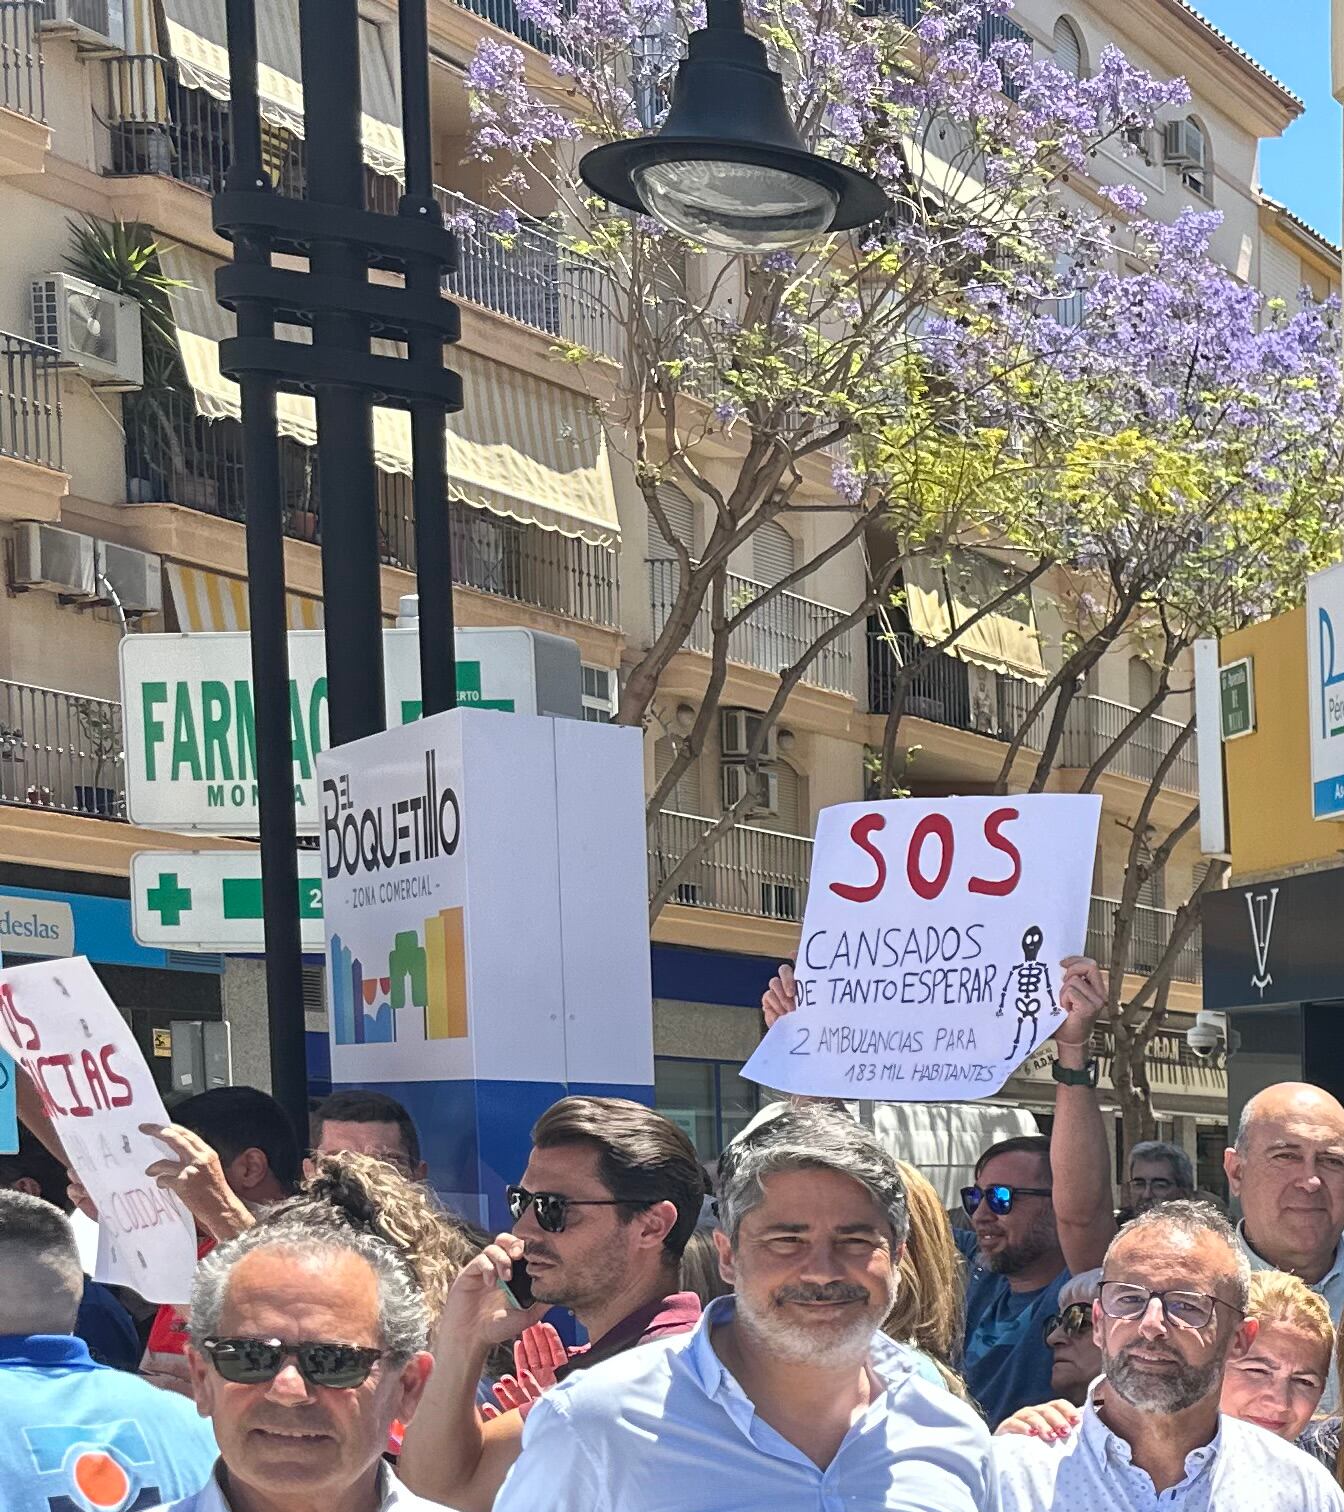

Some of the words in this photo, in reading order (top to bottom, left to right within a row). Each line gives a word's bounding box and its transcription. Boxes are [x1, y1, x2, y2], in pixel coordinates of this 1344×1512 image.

[829, 808, 1022, 903] SOS
[352, 886, 376, 908] ZONA
[379, 875, 432, 903] COMERCIAL
[805, 923, 984, 970] CANSADOS
[795, 978, 816, 1007] DE
[828, 977, 897, 1005] TANTO
[900, 964, 998, 1004] ESPERAR
[789, 1028, 811, 1055] 2
[817, 1026, 923, 1055] AMBULANCIAS
[935, 1027, 976, 1051] PARA
[845, 1064, 876, 1083] 183
[881, 1064, 905, 1082] MIL
[911, 1063, 998, 1083] HABITANTES
